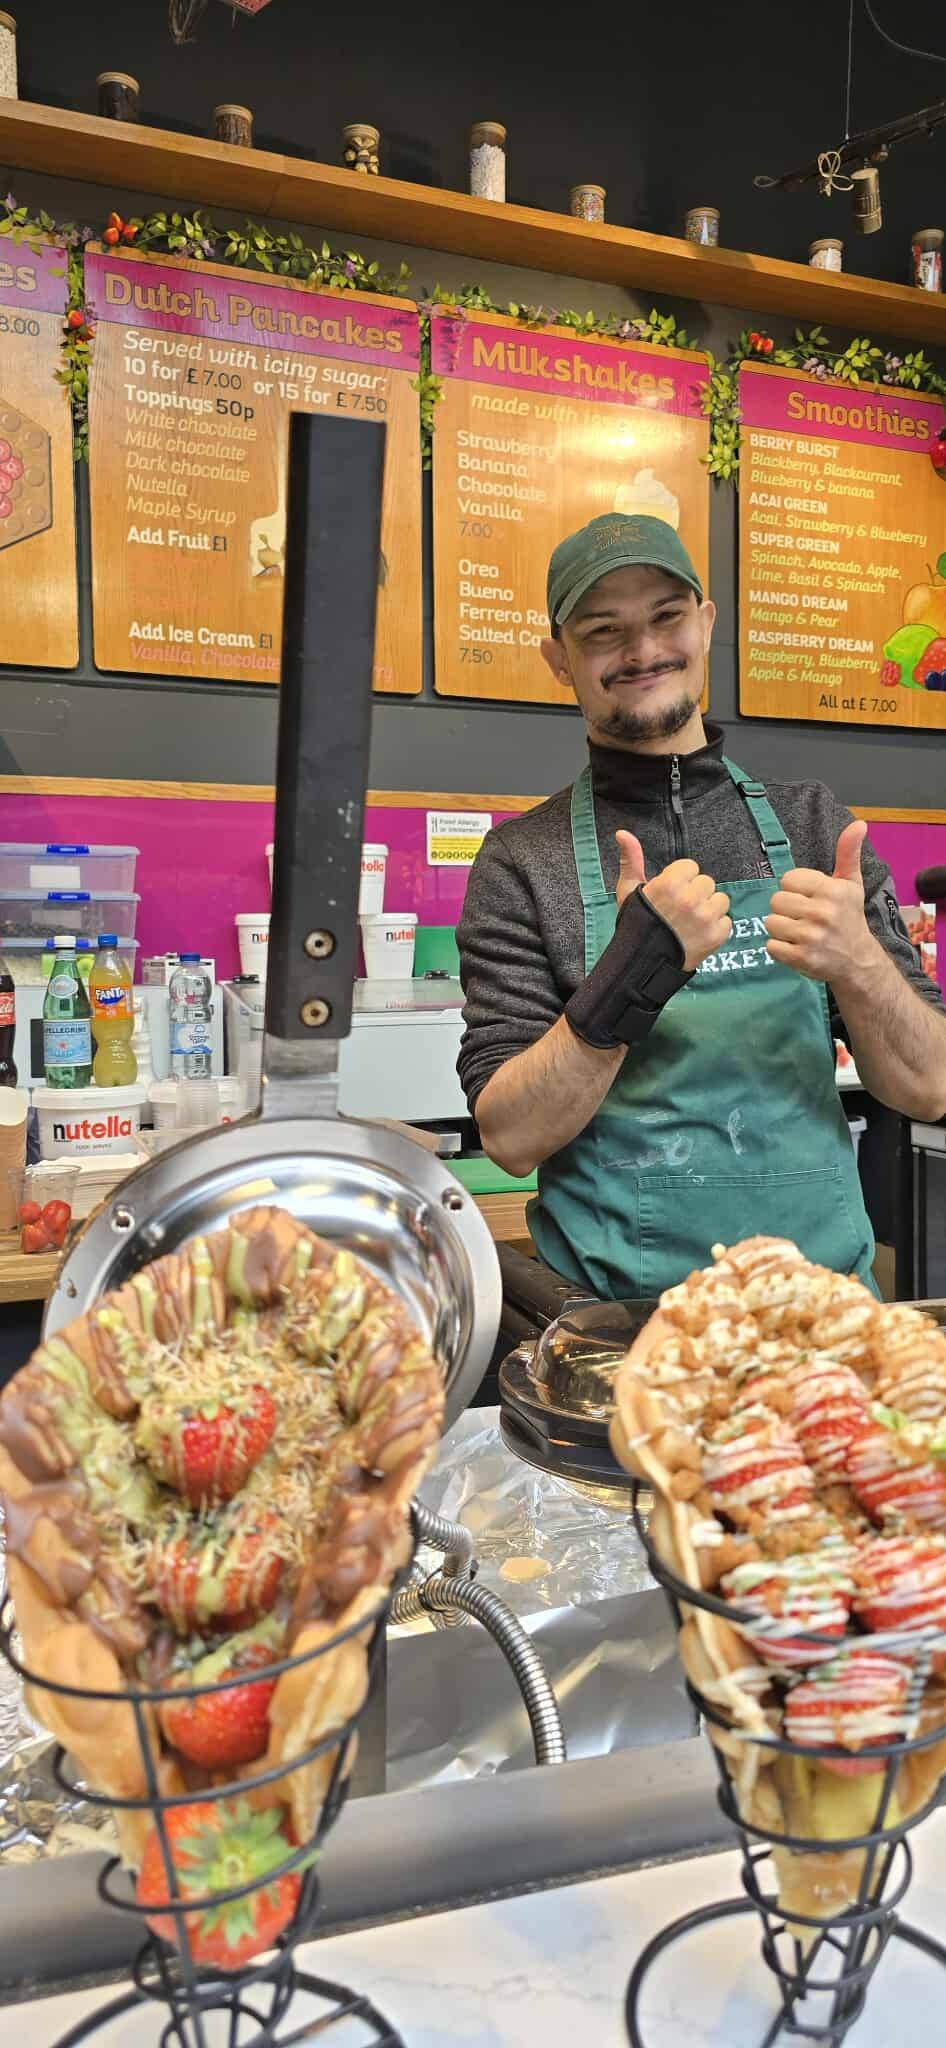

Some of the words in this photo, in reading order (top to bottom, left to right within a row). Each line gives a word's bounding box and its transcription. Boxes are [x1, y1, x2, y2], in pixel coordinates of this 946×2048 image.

[105, 272, 220, 322] Dutch
[228, 295, 403, 353] Pancakes
[123, 330, 203, 360] Served
[209, 347, 258, 370] with
[263, 354, 318, 383] icing
[472, 336, 676, 401] Milkshakes
[123, 356, 146, 375] 10
[151, 360, 181, 381] for
[187, 367, 199, 384] £
[203, 369, 242, 390] 7.00
[253, 381, 274, 396] or
[279, 381, 299, 400] 15
[303, 385, 333, 405] for
[336, 391, 347, 407] £
[350, 393, 387, 413] 7.50
[123, 384, 213, 415] Toppings
[216, 398, 254, 422] 50p
[471, 394, 530, 416] made
[534, 403, 577, 424] with
[787, 390, 929, 440] Smoothies
[126, 407, 175, 430] White
[178, 416, 257, 441] chocolate
[126, 430, 162, 449] Milk
[166, 435, 246, 461] chocolate
[457, 430, 554, 464] Strawberry
[750, 433, 794, 451] BERRY
[796, 440, 840, 459] BURST
[126, 451, 167, 472] Dark
[171, 458, 250, 483] chocolate
[458, 452, 528, 479] Banana
[824, 462, 903, 487] Blackcurrant,
[127, 473, 188, 497] Nutella
[458, 475, 546, 502] Chocolate
[751, 470, 812, 493] Blueberry
[814, 479, 825, 492] &
[828, 481, 875, 499] banana
[127, 495, 181, 519] Maple
[185, 503, 237, 528] Syrup
[457, 497, 524, 522] Vanilla
[749, 492, 781, 508] ACAI
[784, 496, 828, 514] GREEN
[127, 525, 164, 545] Add
[168, 530, 211, 551] Fruit
[459, 520, 493, 539] 7.00
[786, 514, 854, 538] Strawberry
[856, 524, 866, 537] &
[871, 525, 928, 547] Blueberry
[749, 531, 794, 548] SUPER
[796, 536, 840, 554] GREEN
[458, 559, 499, 578] Oreo
[808, 556, 863, 575] Avocado,
[867, 563, 902, 580] Apple,
[459, 581, 514, 602] Bueno
[788, 571, 820, 587] Basil
[822, 575, 833, 588] &
[836, 577, 885, 594] Spinach
[459, 602, 522, 624] Ferrero
[749, 590, 798, 606] MANGO
[802, 595, 848, 612] DREAM
[750, 607, 794, 625] Mango
[796, 612, 807, 624] &
[810, 613, 840, 628] Pear
[128, 621, 165, 641] Add
[168, 625, 193, 643] Ice
[198, 627, 255, 648] Cream
[459, 624, 516, 645] Salted
[749, 630, 826, 649] RASPBERRY
[829, 638, 874, 654] DREAM
[459, 647, 493, 664] 7.50
[819, 654, 880, 675] Blueberry,
[748, 666, 785, 682] Apple
[786, 669, 798, 681] &
[800, 671, 843, 687] Mango
[819, 694, 838, 709] All
[842, 698, 855, 710] at
[859, 697, 867, 711] £
[871, 698, 897, 712] 7.00
[728, 915, 769, 939] EN
[695, 946, 775, 974] RKET
[53, 1115, 132, 1140] nutella
